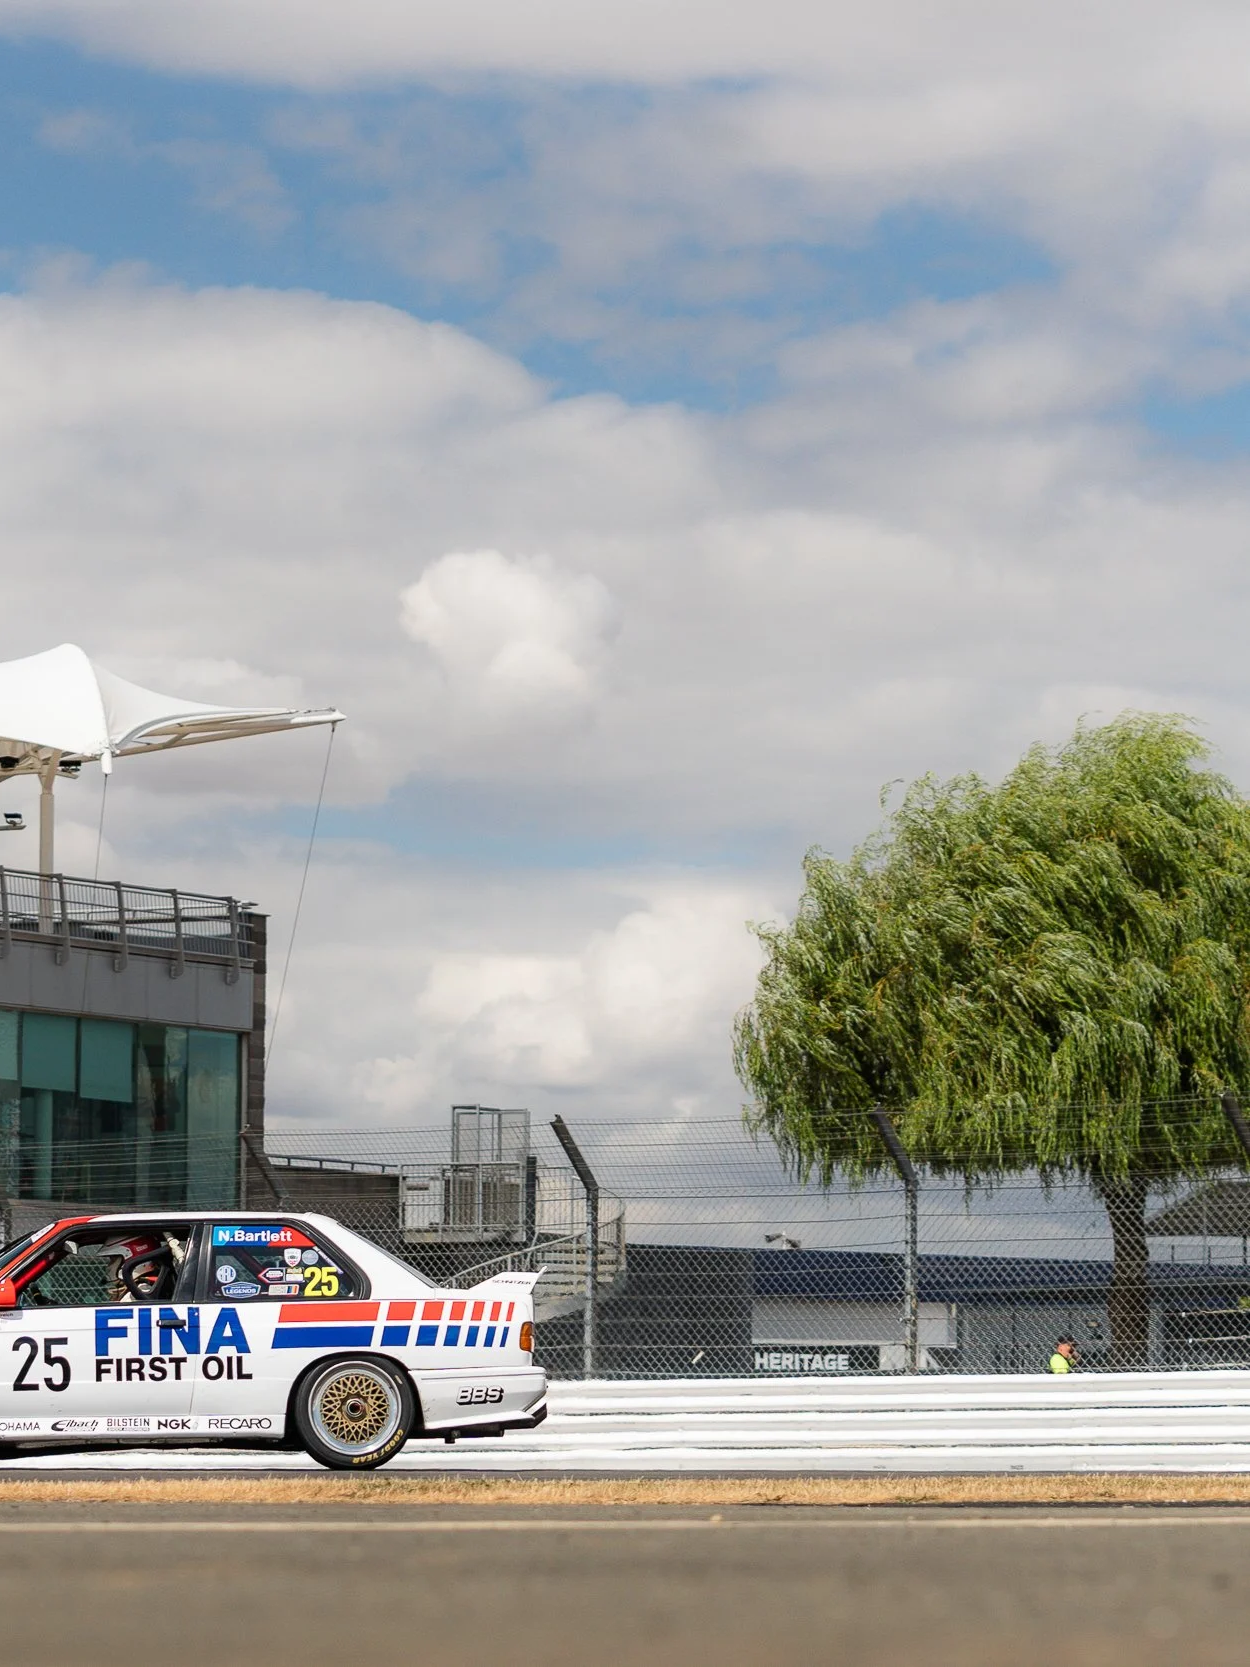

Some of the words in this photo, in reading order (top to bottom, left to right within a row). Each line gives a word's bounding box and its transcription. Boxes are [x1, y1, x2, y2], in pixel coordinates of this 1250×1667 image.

[218, 1230, 292, 1242] N.Bartlett
[303, 1266, 339, 1297] 25
[95, 1307, 251, 1356] FINA
[11, 1336, 72, 1392] 25
[95, 1356, 187, 1382] FIRST
[202, 1356, 253, 1380] OIL
[754, 1351, 849, 1371] HERITAGE
[456, 1386, 505, 1406] BBS
[50, 1419, 99, 1432] Eibach
[106, 1417, 150, 1427] BILSTEIN
[157, 1419, 192, 1430] NGK
[208, 1417, 272, 1430] RECARO
